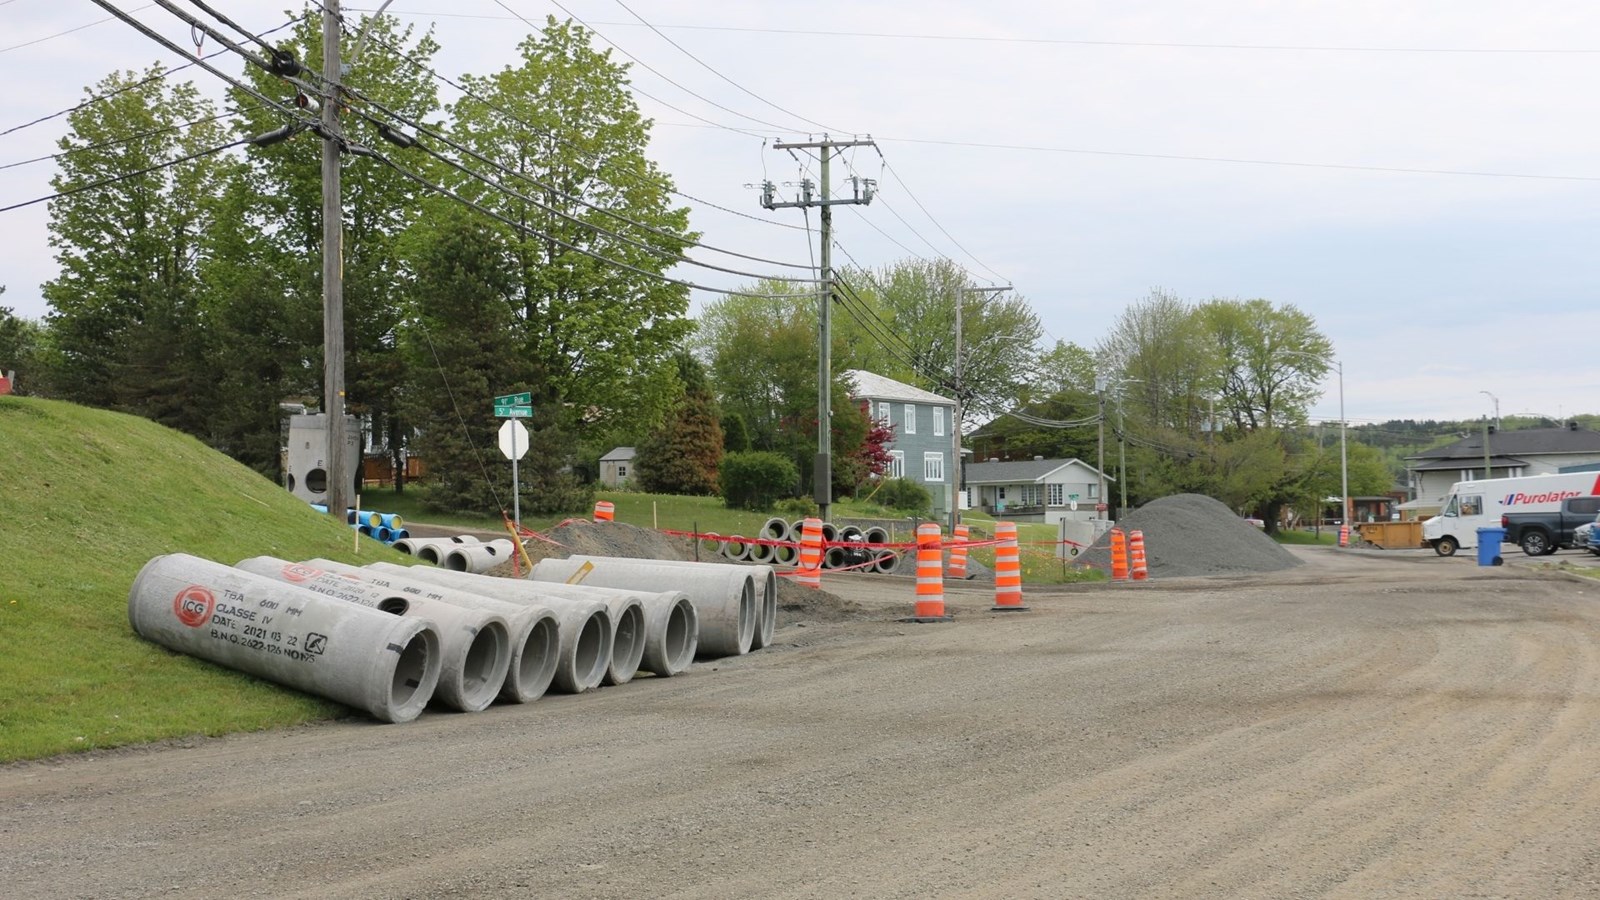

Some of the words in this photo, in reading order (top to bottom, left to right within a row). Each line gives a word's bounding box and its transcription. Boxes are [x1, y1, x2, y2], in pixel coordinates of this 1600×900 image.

[509, 408, 528, 416] Avenue
[182, 599, 204, 615] ICG
[216, 603, 257, 622] CLASSE
[261, 616, 273, 625] IV
[224, 589, 245, 602] TBA
[259, 599, 279, 610] 600
[285, 606, 304, 617] MM
[211, 614, 237, 630] DATE
[243, 624, 267, 640] 2021
[270, 631, 282, 642] 03
[286, 635, 298, 647] 22
